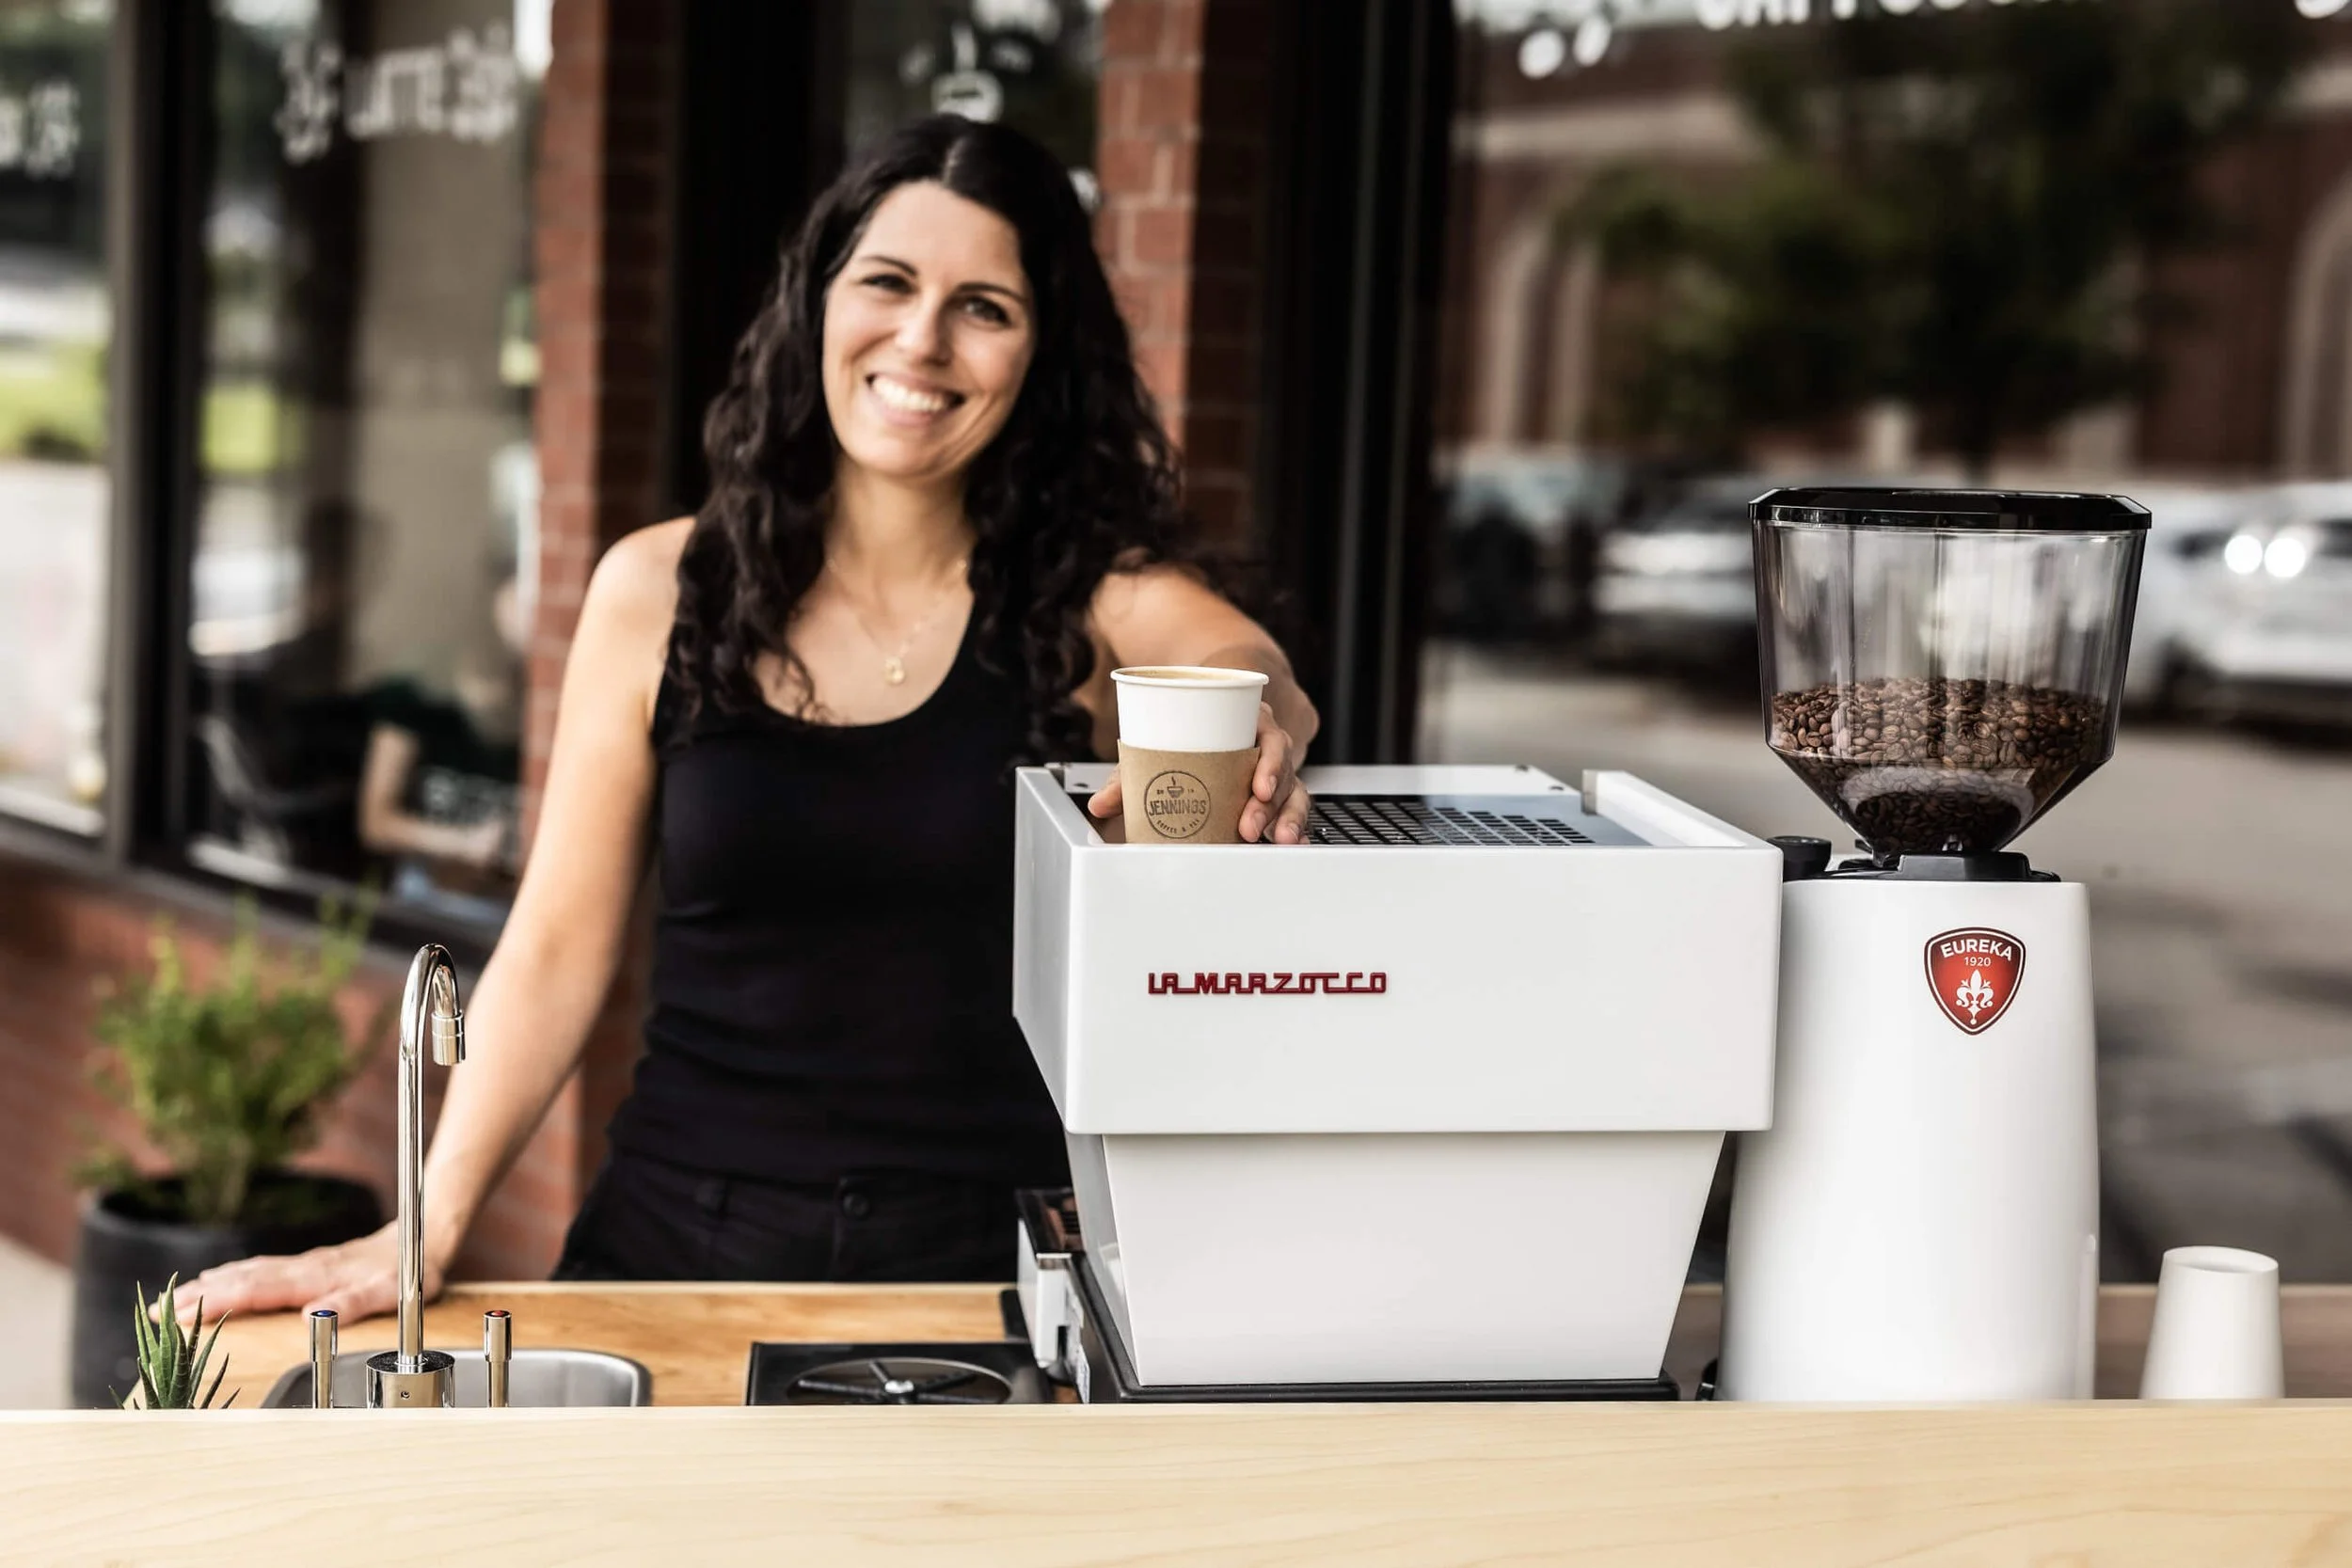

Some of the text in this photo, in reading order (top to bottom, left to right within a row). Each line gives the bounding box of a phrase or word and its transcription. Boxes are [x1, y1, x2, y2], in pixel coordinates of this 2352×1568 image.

[1149, 799, 1207, 816] JENNINGS
[1940, 939, 2012, 961] EUREKA
[1964, 957, 1992, 966] 1920
[1148, 972, 1387, 994] LA MARZOCCO
